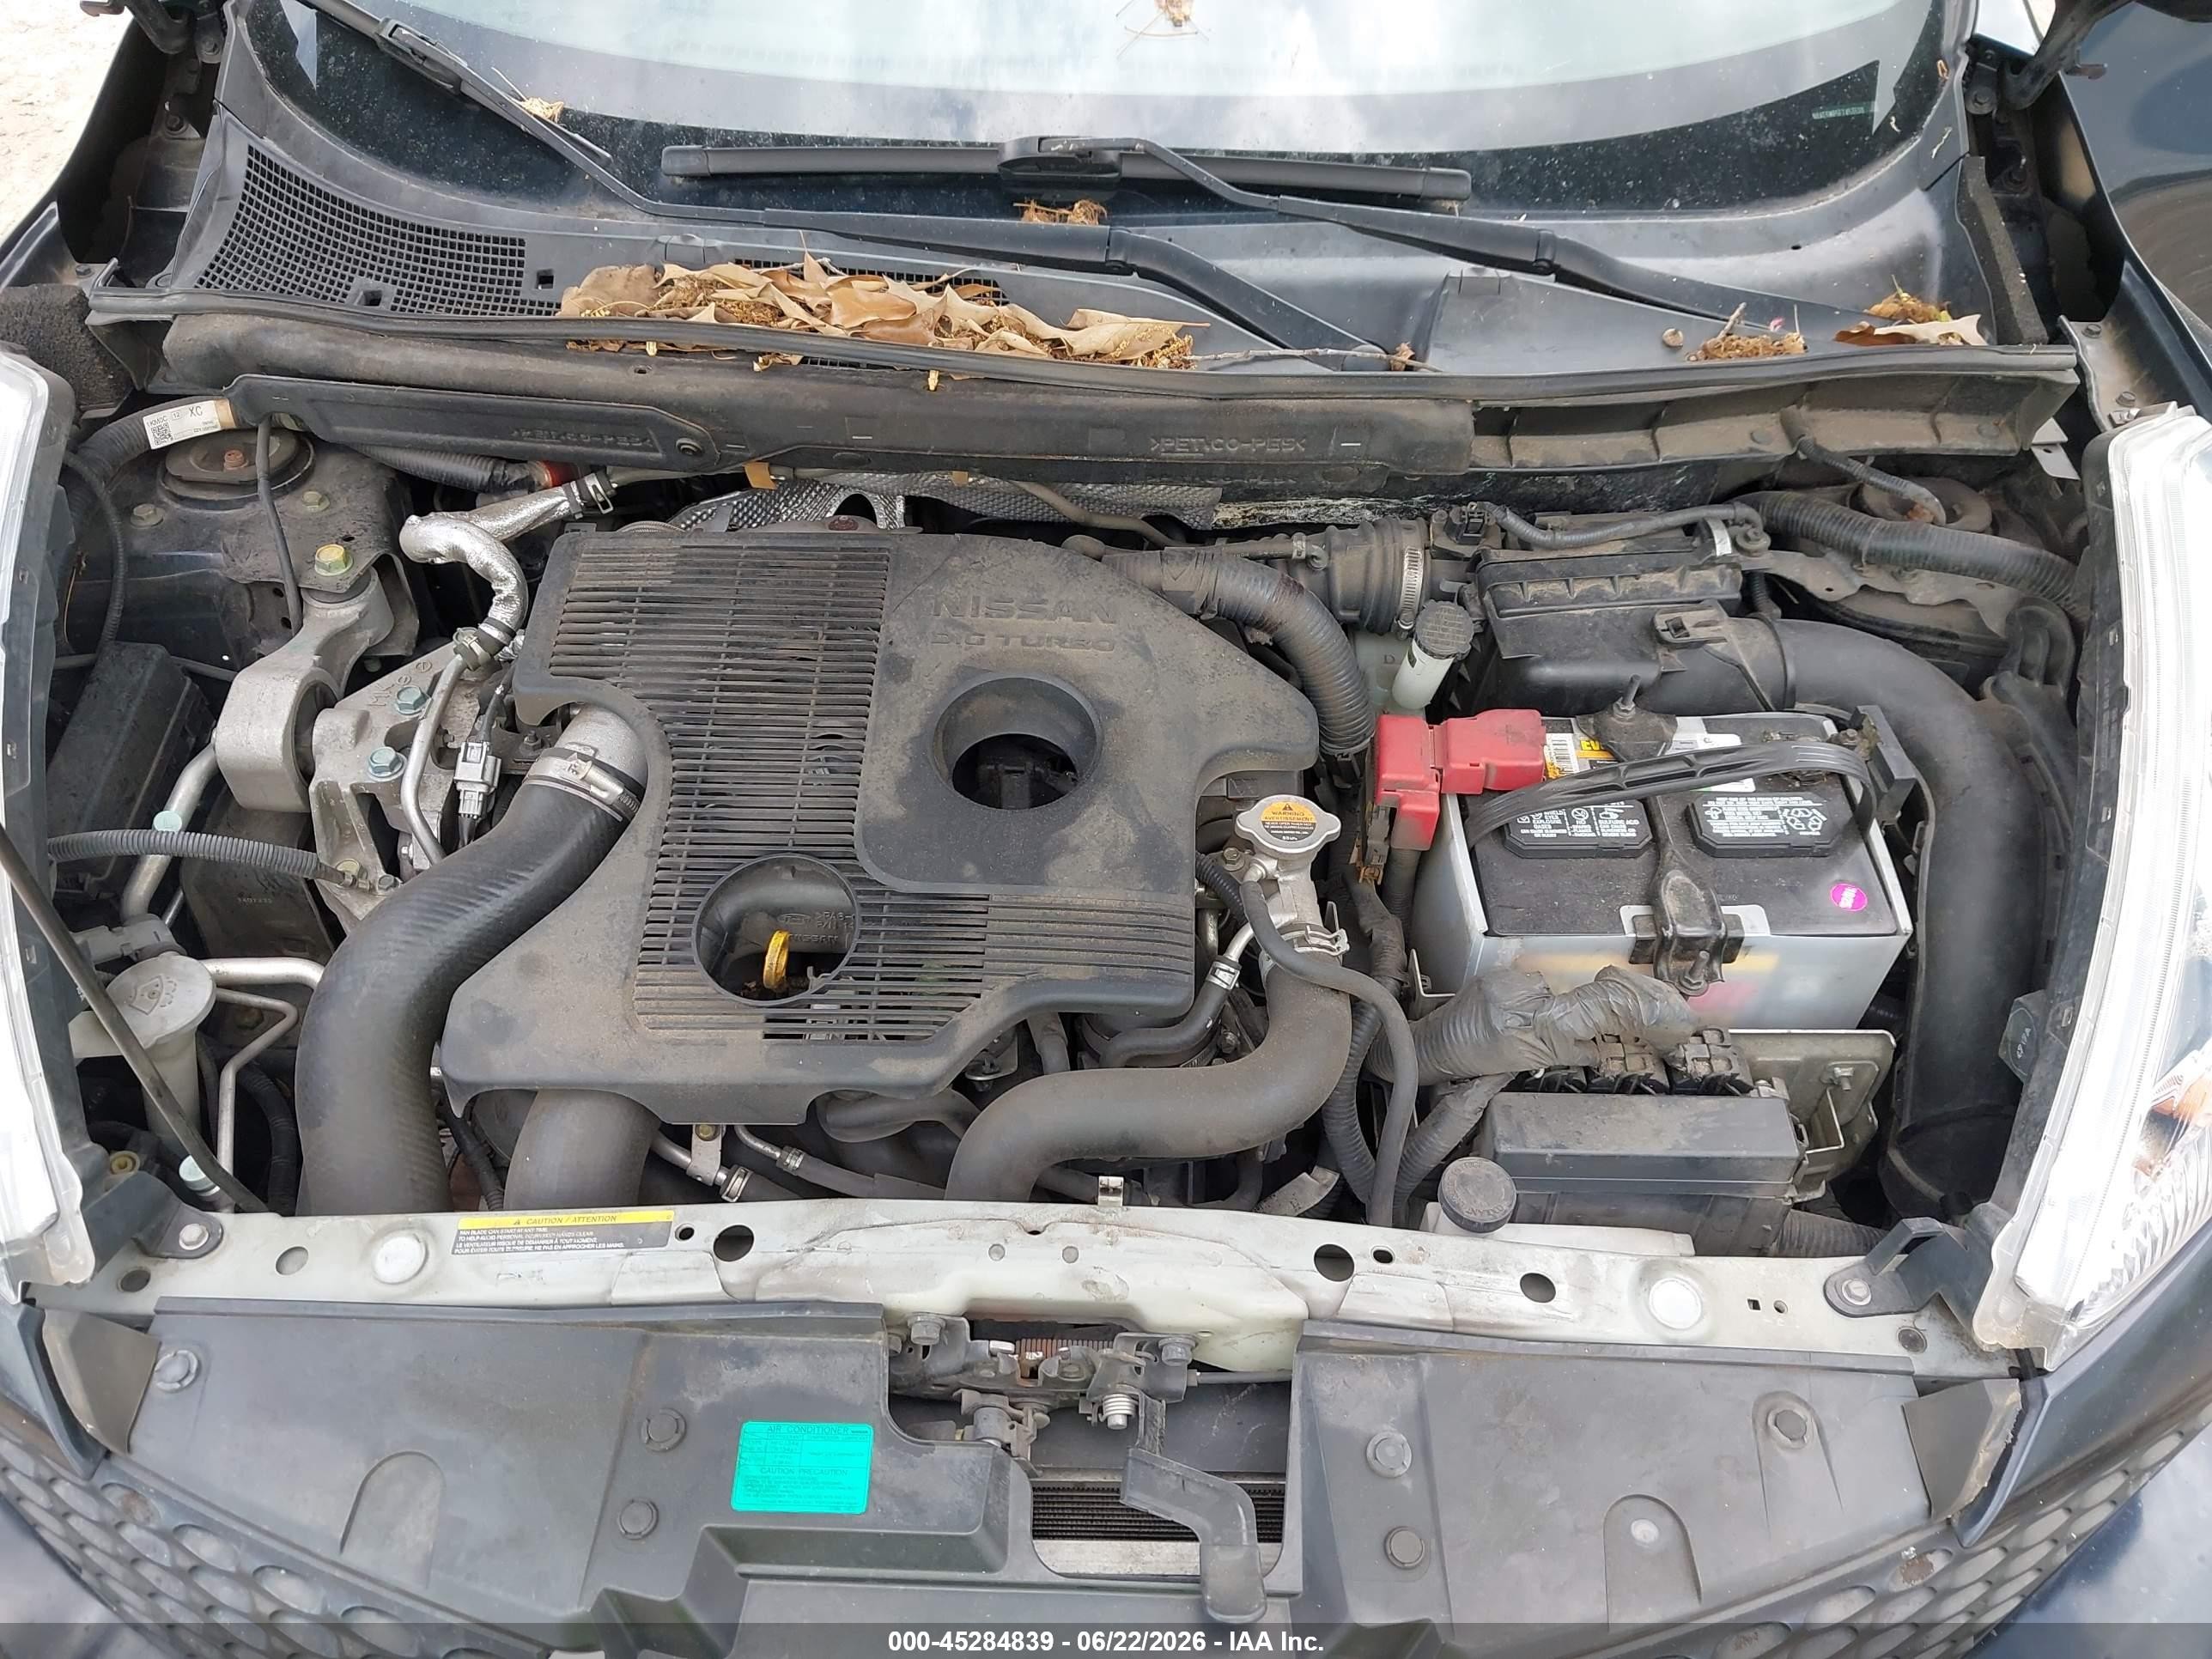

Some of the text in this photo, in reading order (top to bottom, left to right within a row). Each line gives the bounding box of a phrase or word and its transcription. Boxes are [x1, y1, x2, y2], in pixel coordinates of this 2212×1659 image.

[188, 405, 204, 417] XC
[933, 596, 1116, 625] NISSAN
[994, 634, 1115, 651] TURBO
[787, 1425, 849, 1434] CONDITIONER
[799, 1468, 848, 1476] PRECAUTION
